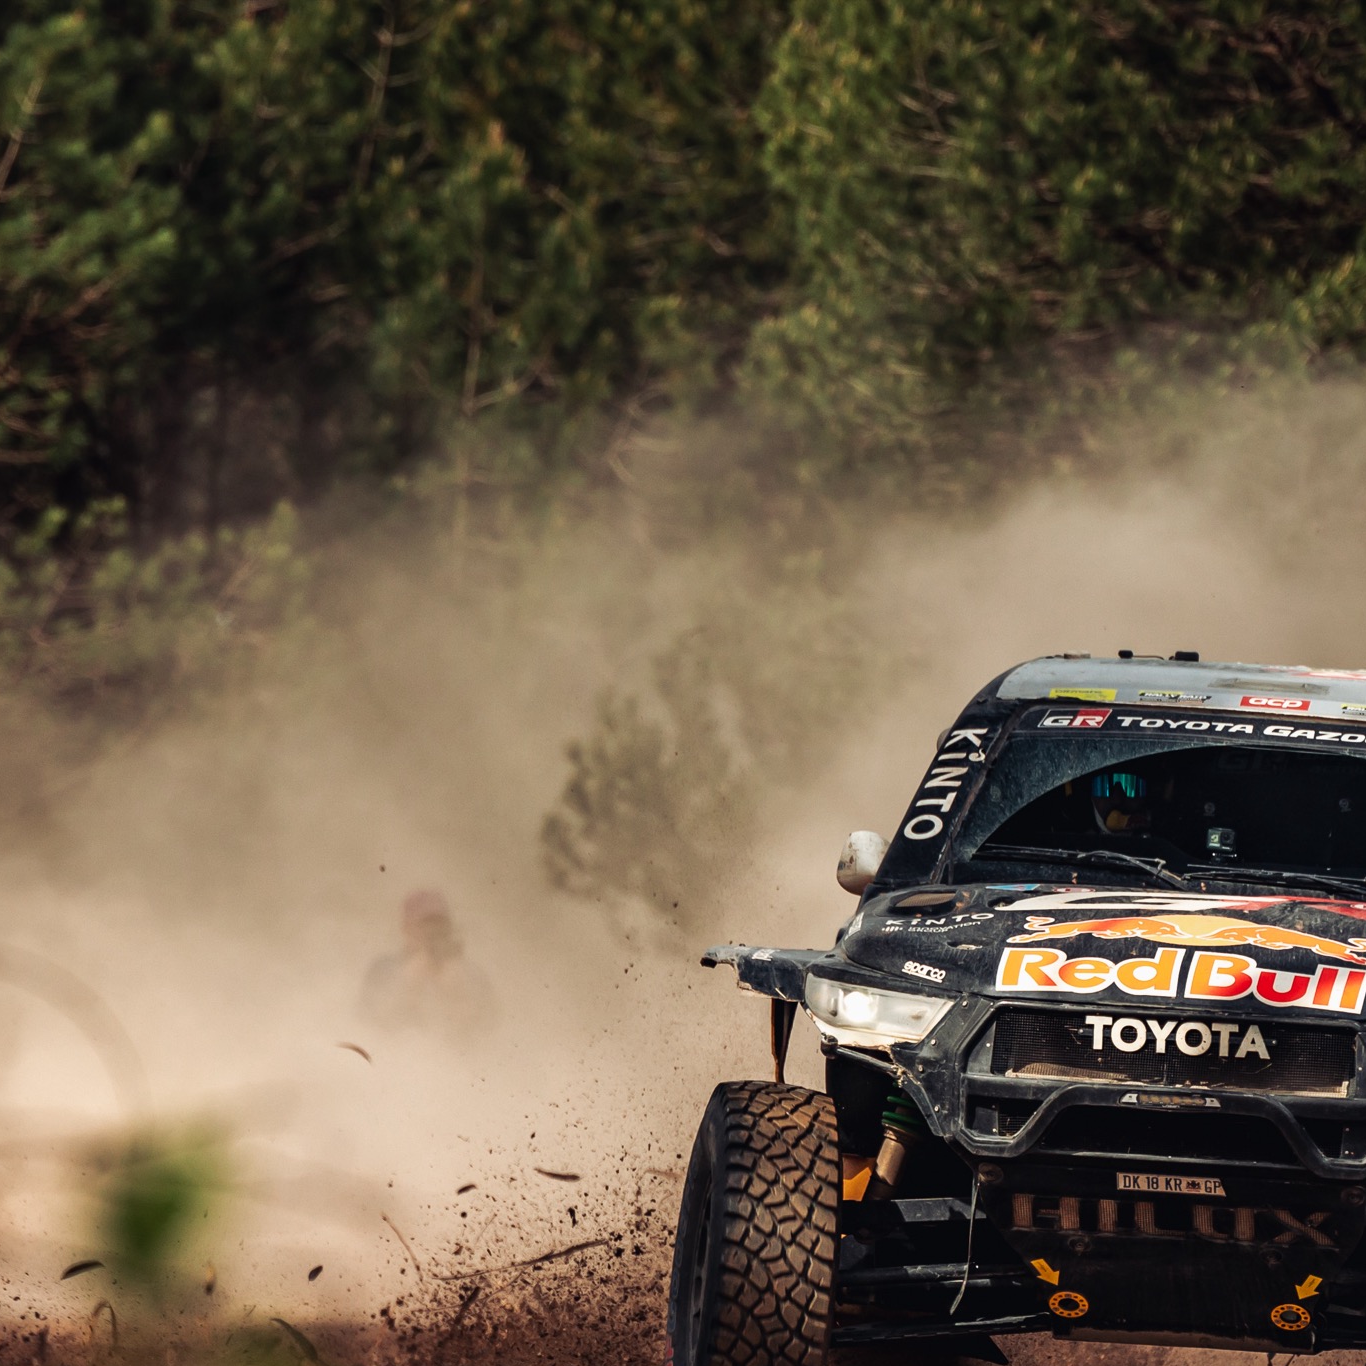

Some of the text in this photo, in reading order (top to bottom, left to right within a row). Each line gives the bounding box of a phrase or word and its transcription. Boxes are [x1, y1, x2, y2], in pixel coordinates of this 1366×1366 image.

[1248, 697, 1303, 709] acp
[1042, 714, 1106, 728] GR
[1117, 716, 1254, 734] TOYOTA
[903, 727, 988, 840] KINTO
[885, 912, 995, 926] KINTO
[903, 960, 946, 982] sparco
[996, 947, 1182, 996] Red
[1085, 1015, 1271, 1060] TOYOTA
[1123, 1174, 1221, 1194] DK 18 KR GP
[1012, 1193, 1336, 1247] HILUX
